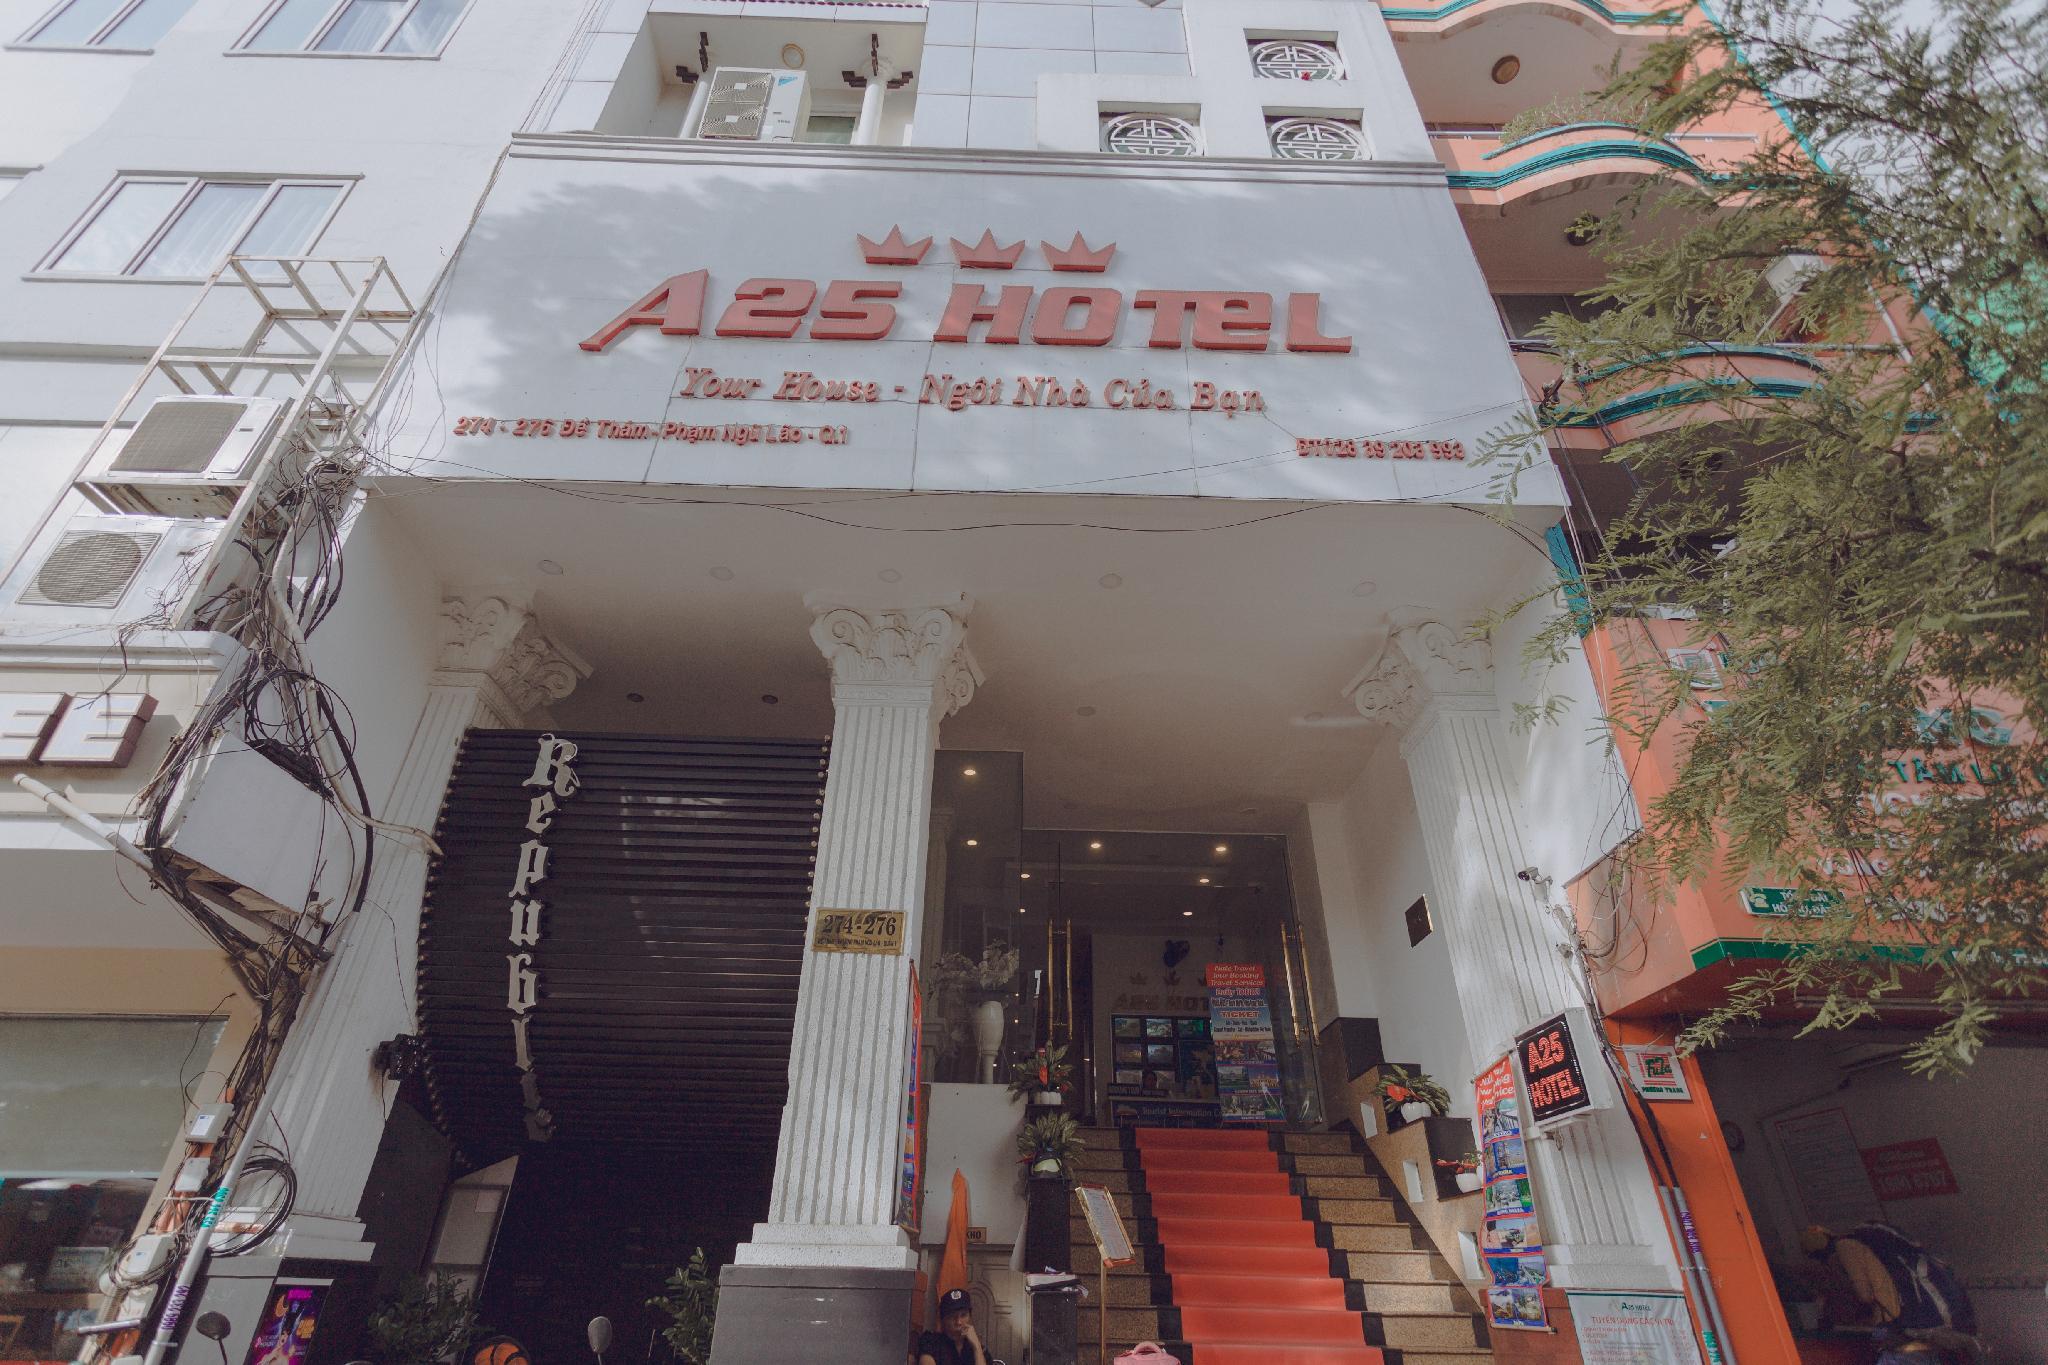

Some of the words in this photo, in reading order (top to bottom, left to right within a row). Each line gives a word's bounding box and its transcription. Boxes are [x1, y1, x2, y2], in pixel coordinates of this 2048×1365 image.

[578, 268, 903, 352] A25
[680, 367, 761, 399] Your
[773, 371, 878, 402] House
[919, 374, 1003, 412] Ngôi
[1012, 376, 1090, 407] Nhà
[1104, 378, 1176, 410] Của
[1190, 381, 1265, 419] Bạn
[453, 416, 497, 437] 274
[512, 417, 554, 437] 276
[1528, 1031, 1565, 1073] A25
[1530, 1068, 1581, 1109] HOTEL
